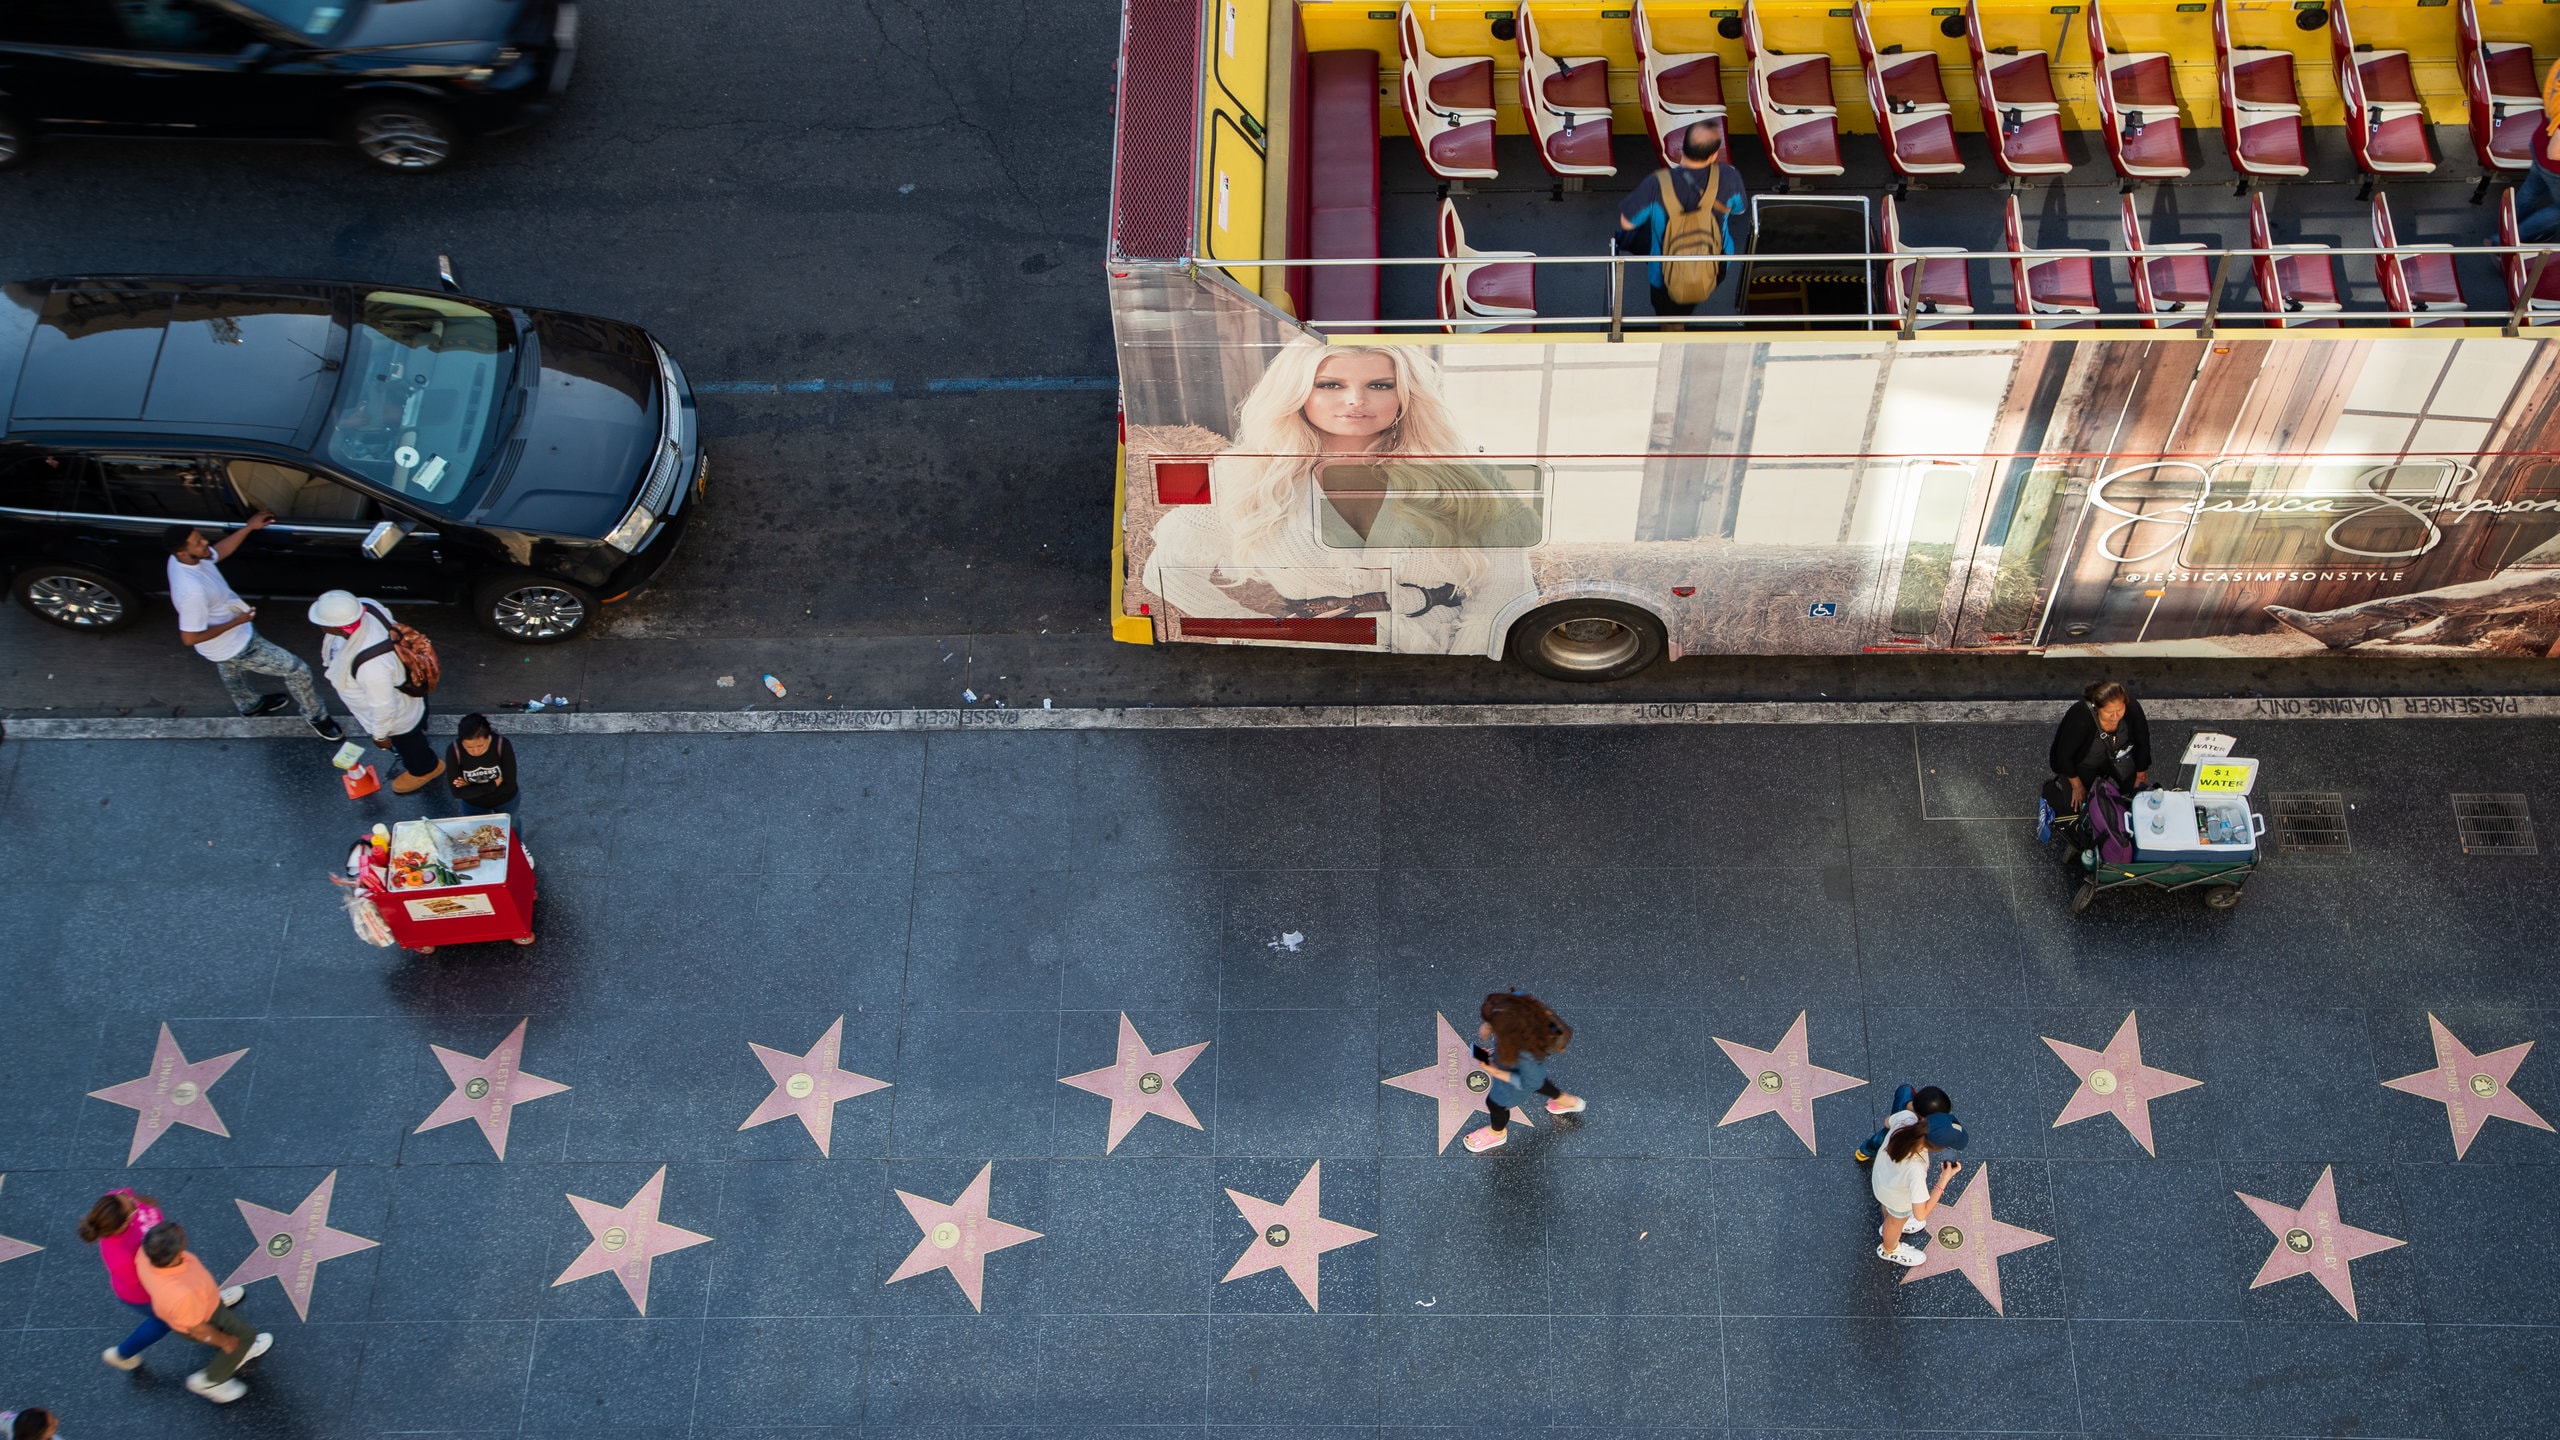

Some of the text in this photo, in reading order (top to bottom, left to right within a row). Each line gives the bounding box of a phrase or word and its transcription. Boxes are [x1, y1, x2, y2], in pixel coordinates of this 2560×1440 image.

[2087, 461, 2346, 562] Jessica
[2125, 571, 2404, 582] @JESSICASIMPSONSTYLE
[826, 711, 900, 725] LOADING
[915, 710, 1019, 724] PASSENGER
[2255, 698, 2518, 716] PASSENGER LOADING ONLY
[2193, 744, 2226, 752] WATER
[2200, 778, 2244, 787] WATER
[488, 1049, 512, 1128] CELESTE HOLM
[1447, 1048, 1460, 1116] BOB THOMAS
[1788, 1051, 1803, 1112] IDA LUPINO
[2119, 1053, 2136, 1114] GIG YOUNG
[2440, 1035, 2469, 1134] PENNY SINGLETON
[816, 1092, 828, 1134] MORGAN
[1122, 1105, 1132, 1117] AL
[967, 1209, 976, 1228] JIM
[2317, 1211, 2337, 1270] RAY DOLBY
[294, 1195, 324, 1294] BARBARA WALTERS
[629, 1230, 646, 1279] SEACREST
[1975, 1231, 1989, 1285] RADCLIFFE
